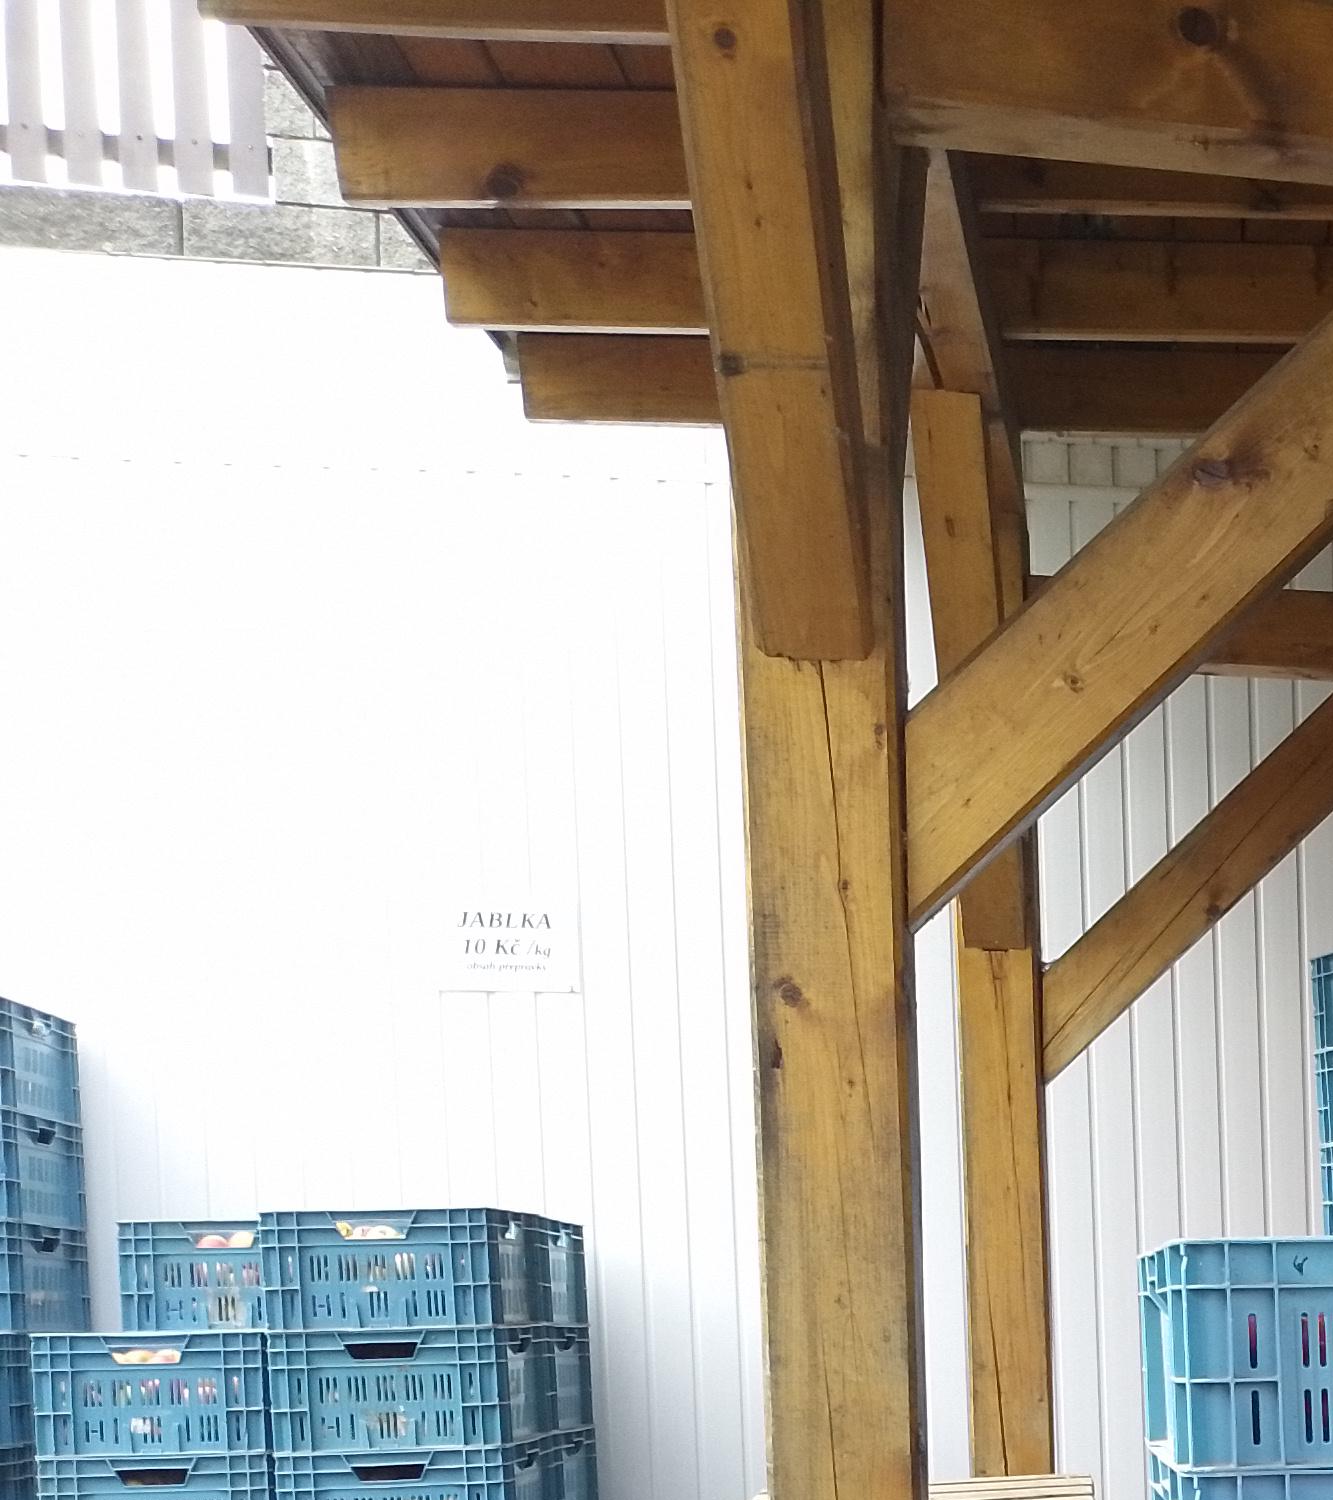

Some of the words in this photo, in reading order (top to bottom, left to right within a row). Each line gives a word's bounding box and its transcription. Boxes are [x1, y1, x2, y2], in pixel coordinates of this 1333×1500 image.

[457, 911, 551, 929] JABLKA
[464, 938, 486, 954] 10
[495, 938, 520, 955] Kč
